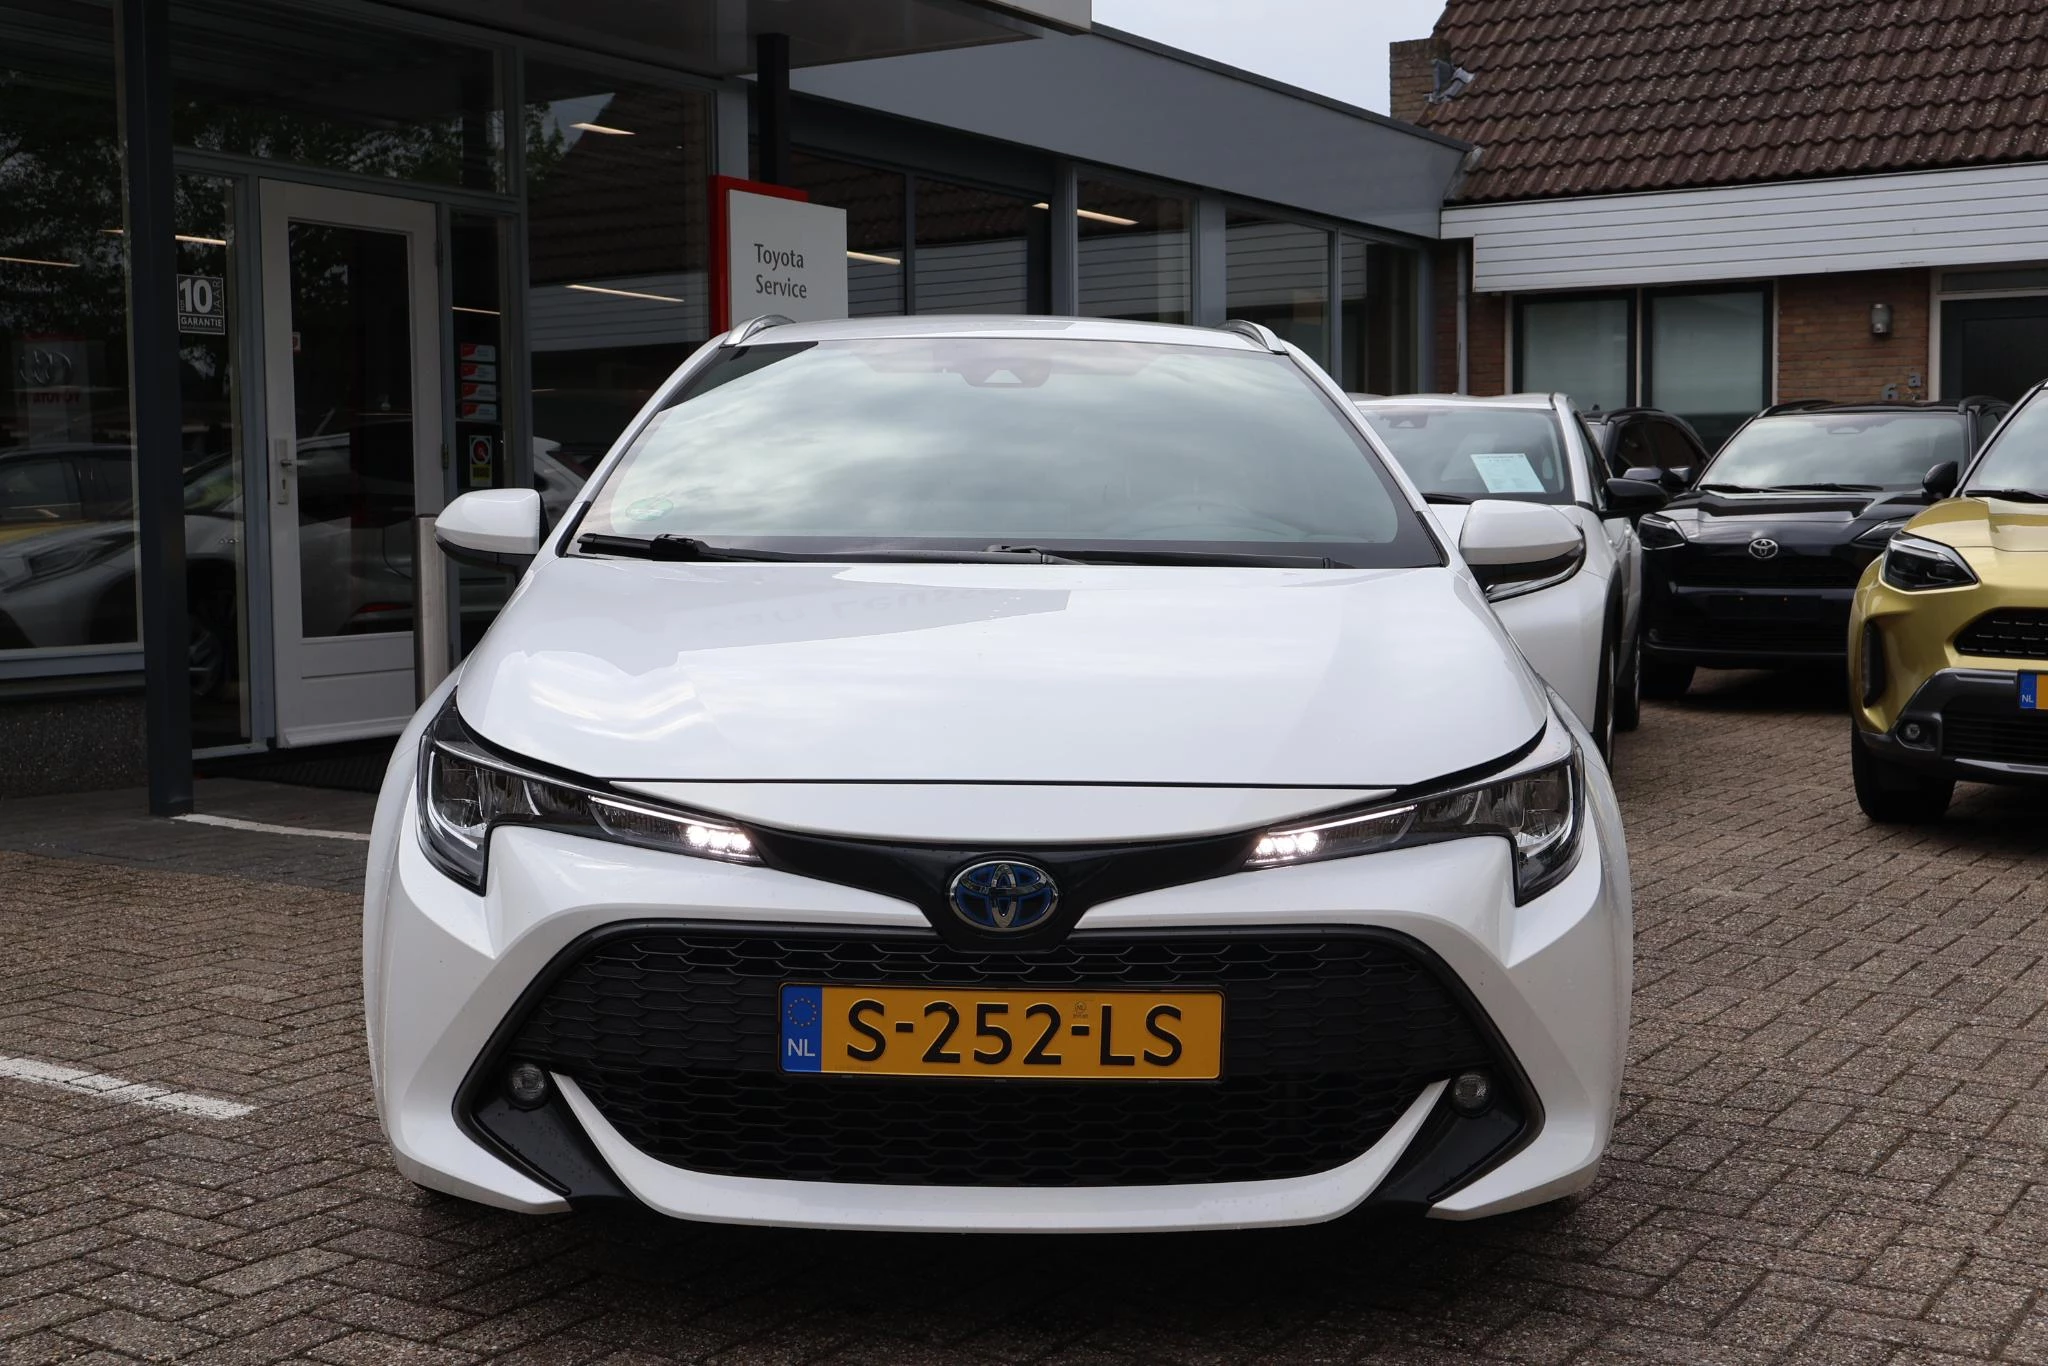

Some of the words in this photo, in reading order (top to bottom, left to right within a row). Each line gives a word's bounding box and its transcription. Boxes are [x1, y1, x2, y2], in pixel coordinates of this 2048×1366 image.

[753, 243, 804, 271] Toyota
[180, 278, 213, 313] 10
[212, 280, 222, 314] JAAR
[755, 274, 807, 299] Service
[181, 317, 222, 327] GARANTIE
[2021, 694, 2034, 703] NL
[846, 998, 1183, 1067] S-252-LS
[787, 1038, 816, 1057] NL
